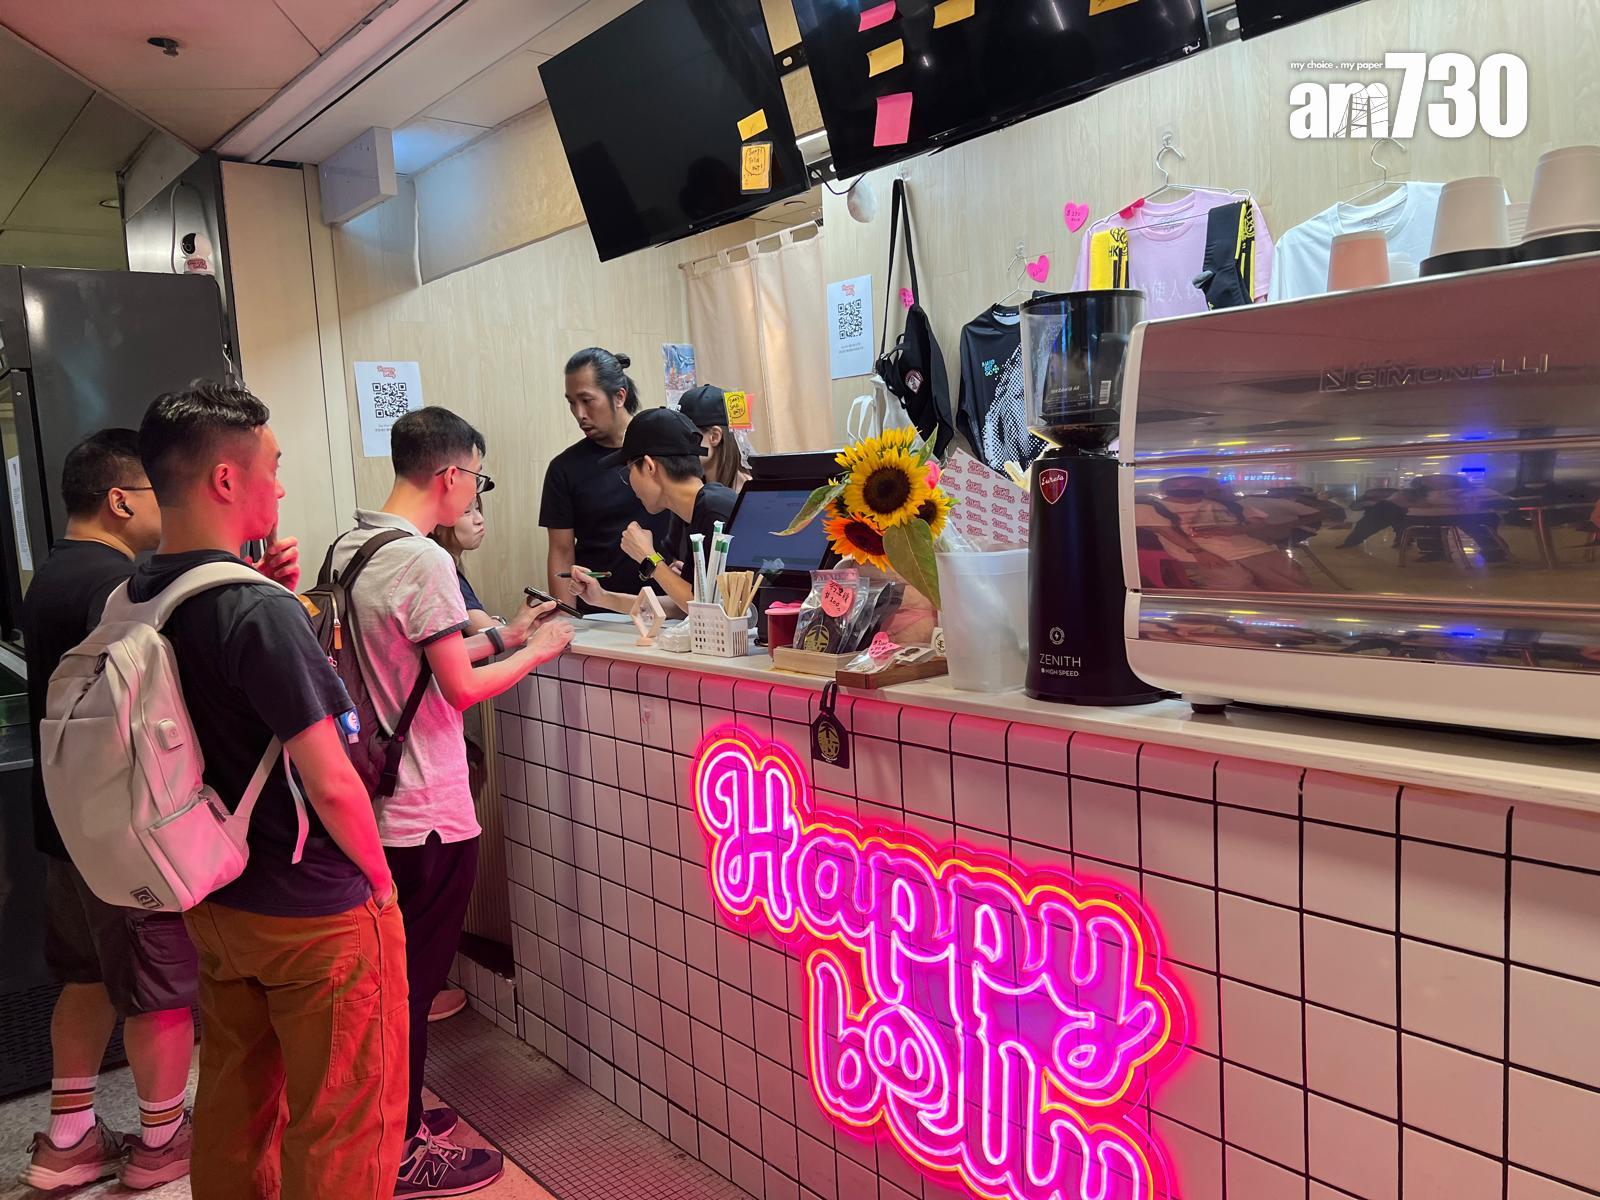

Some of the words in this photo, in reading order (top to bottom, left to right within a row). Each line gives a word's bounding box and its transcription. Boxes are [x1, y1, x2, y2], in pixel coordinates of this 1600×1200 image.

[1039, 653, 1081, 667] ZENITH
[700, 748, 1160, 1090] Happy
[413, 1159, 449, 1188] N
